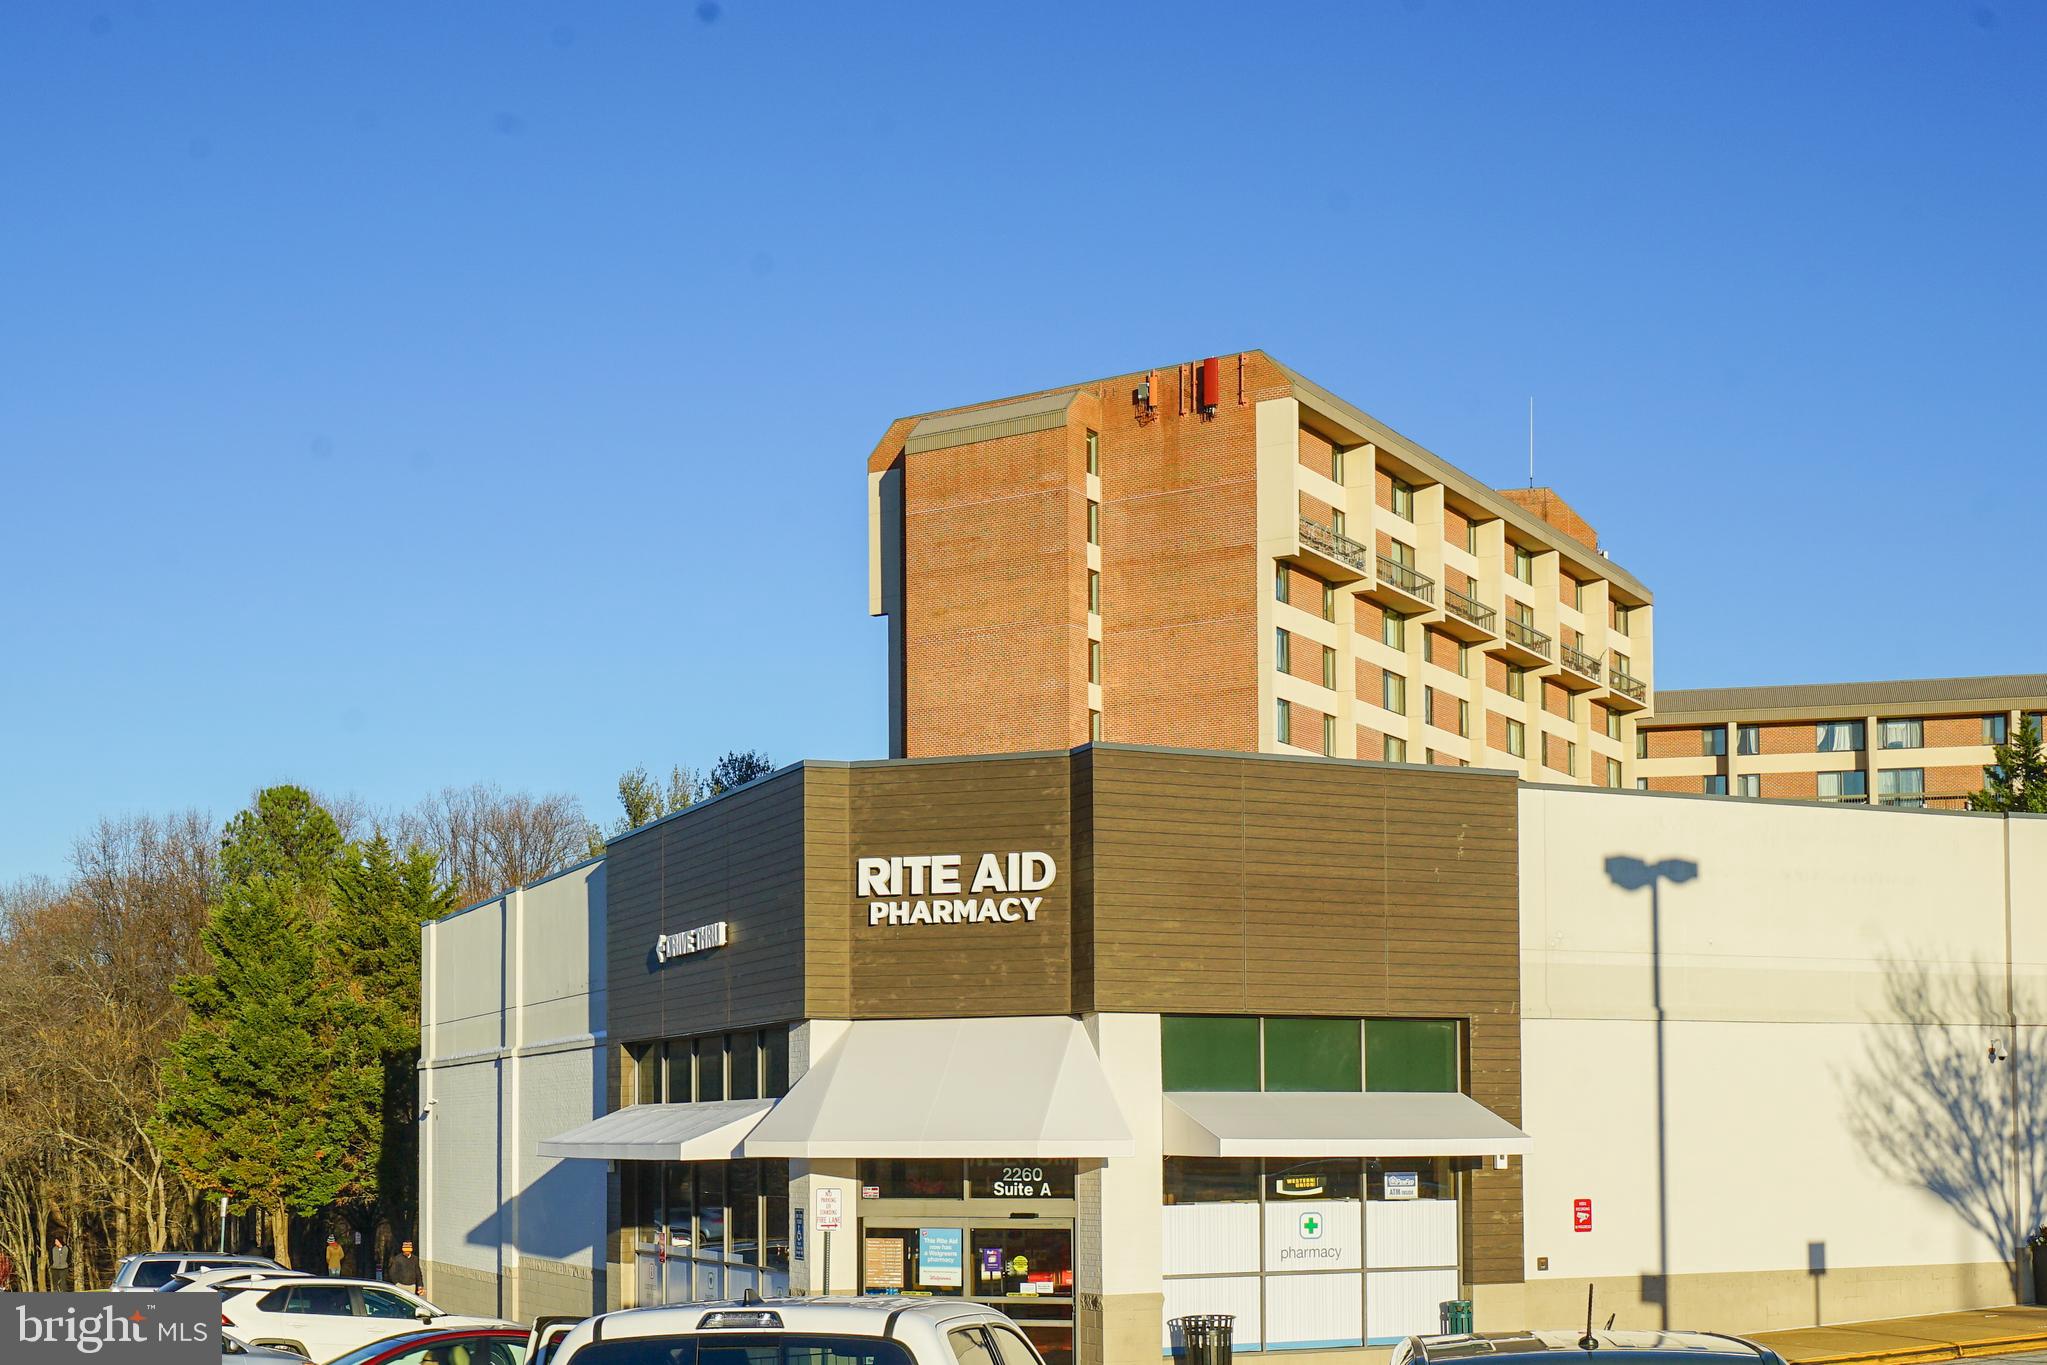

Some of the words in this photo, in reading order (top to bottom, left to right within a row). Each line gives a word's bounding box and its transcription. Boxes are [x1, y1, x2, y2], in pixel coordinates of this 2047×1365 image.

[857, 855, 961, 896] RITE
[971, 851, 1057, 893] AID
[870, 896, 1043, 926] PHARMACY
[665, 930, 695, 958] DRIVE
[695, 921, 728, 951] THRU
[1002, 1167, 1043, 1182] 2260
[993, 1181, 1034, 1196] Suite
[1040, 1182, 1052, 1196] A
[929, 1250, 958, 1258] Walgreens
[1280, 1245, 1342, 1263] pharmacy
